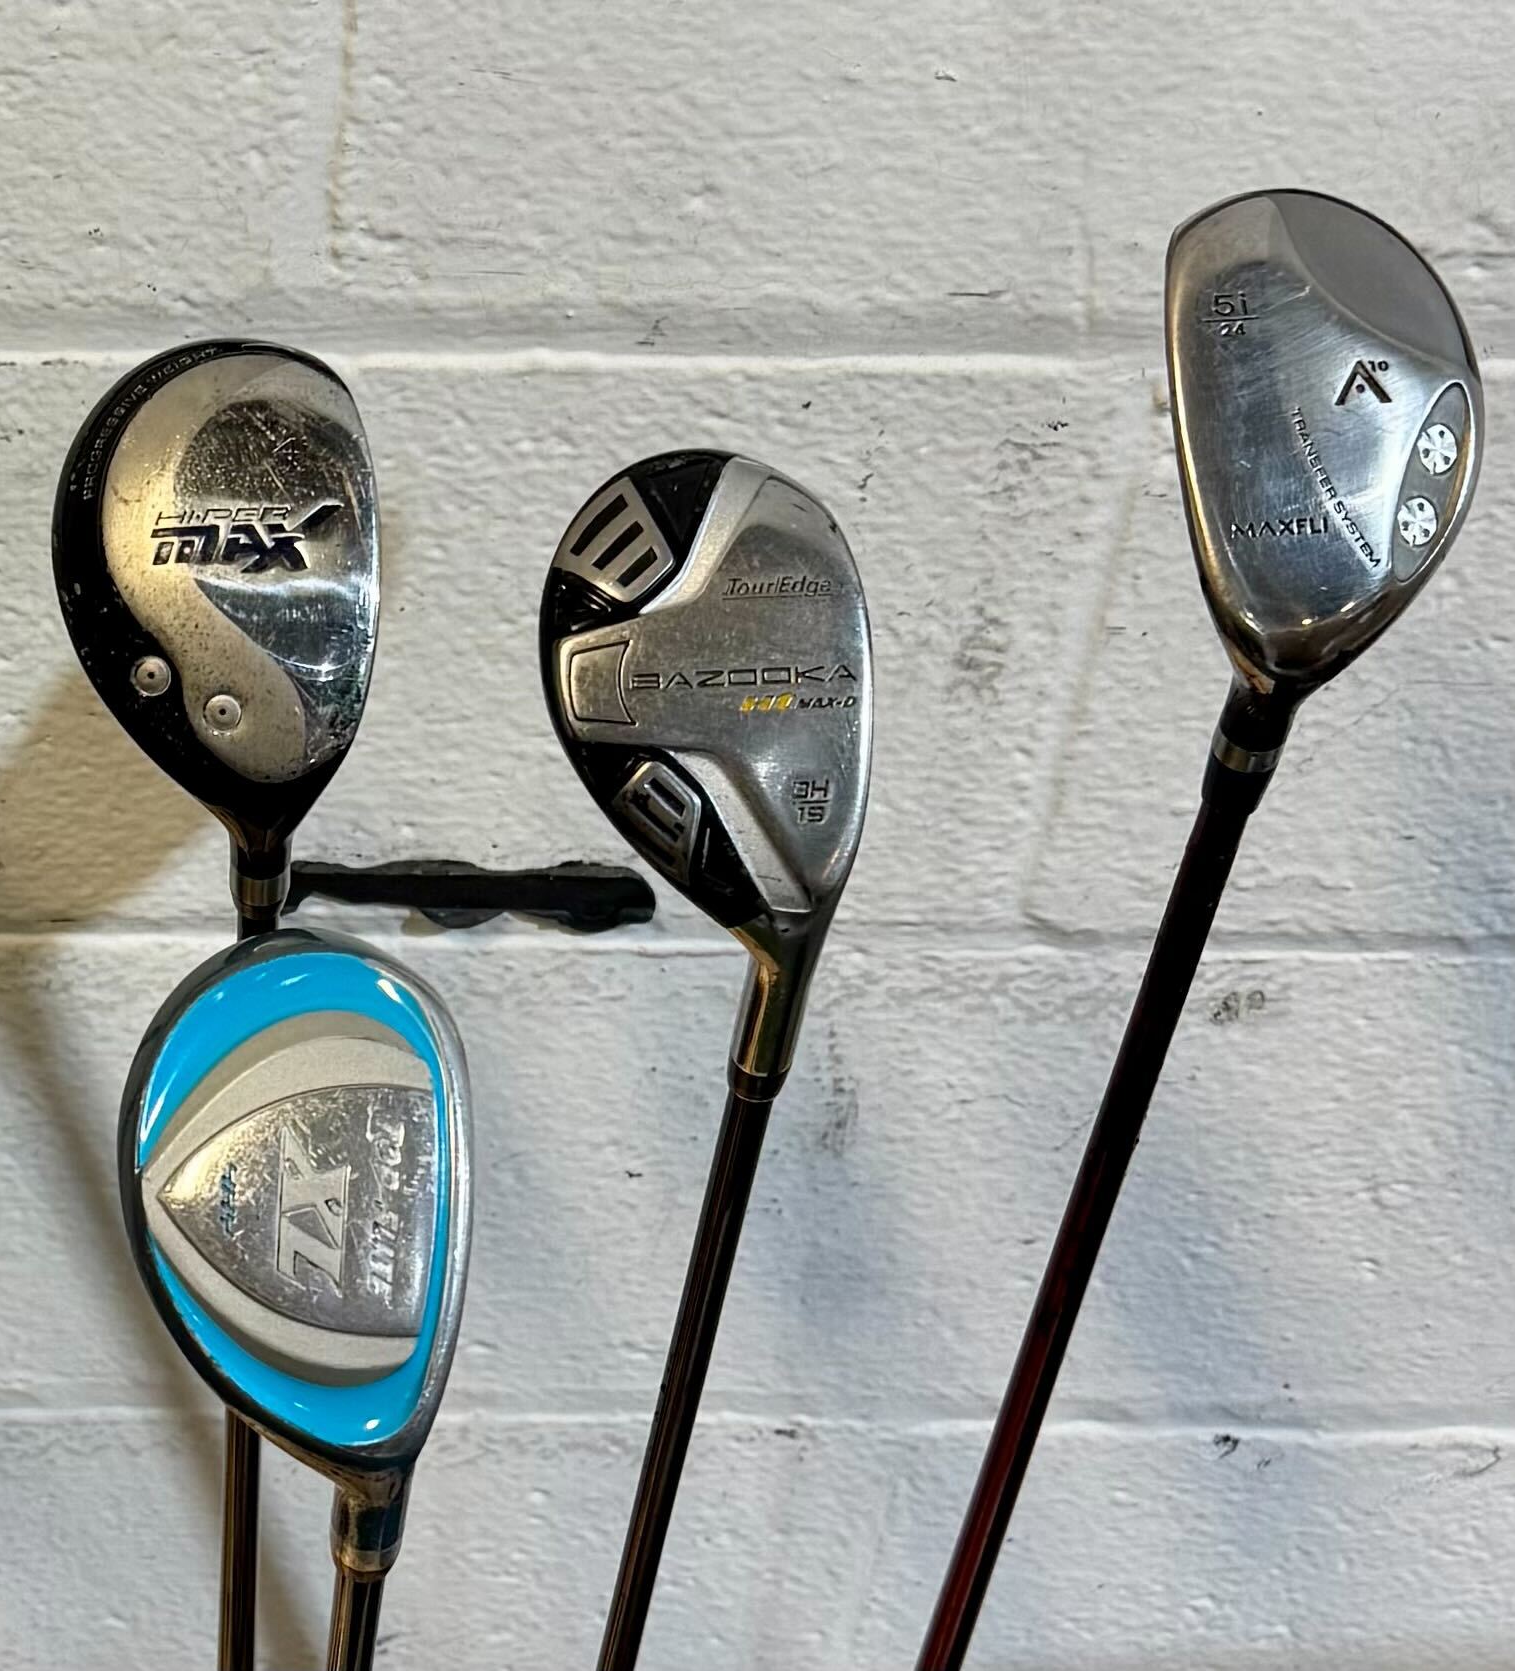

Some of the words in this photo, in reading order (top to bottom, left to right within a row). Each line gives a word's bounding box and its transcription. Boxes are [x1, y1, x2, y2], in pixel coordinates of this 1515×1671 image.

[1213, 292, 1248, 316] 5i
[1230, 516, 1329, 540] MAXFLI
[1333, 499, 1381, 568] SYSTEM
[631, 664, 857, 690] BAZOOKA
